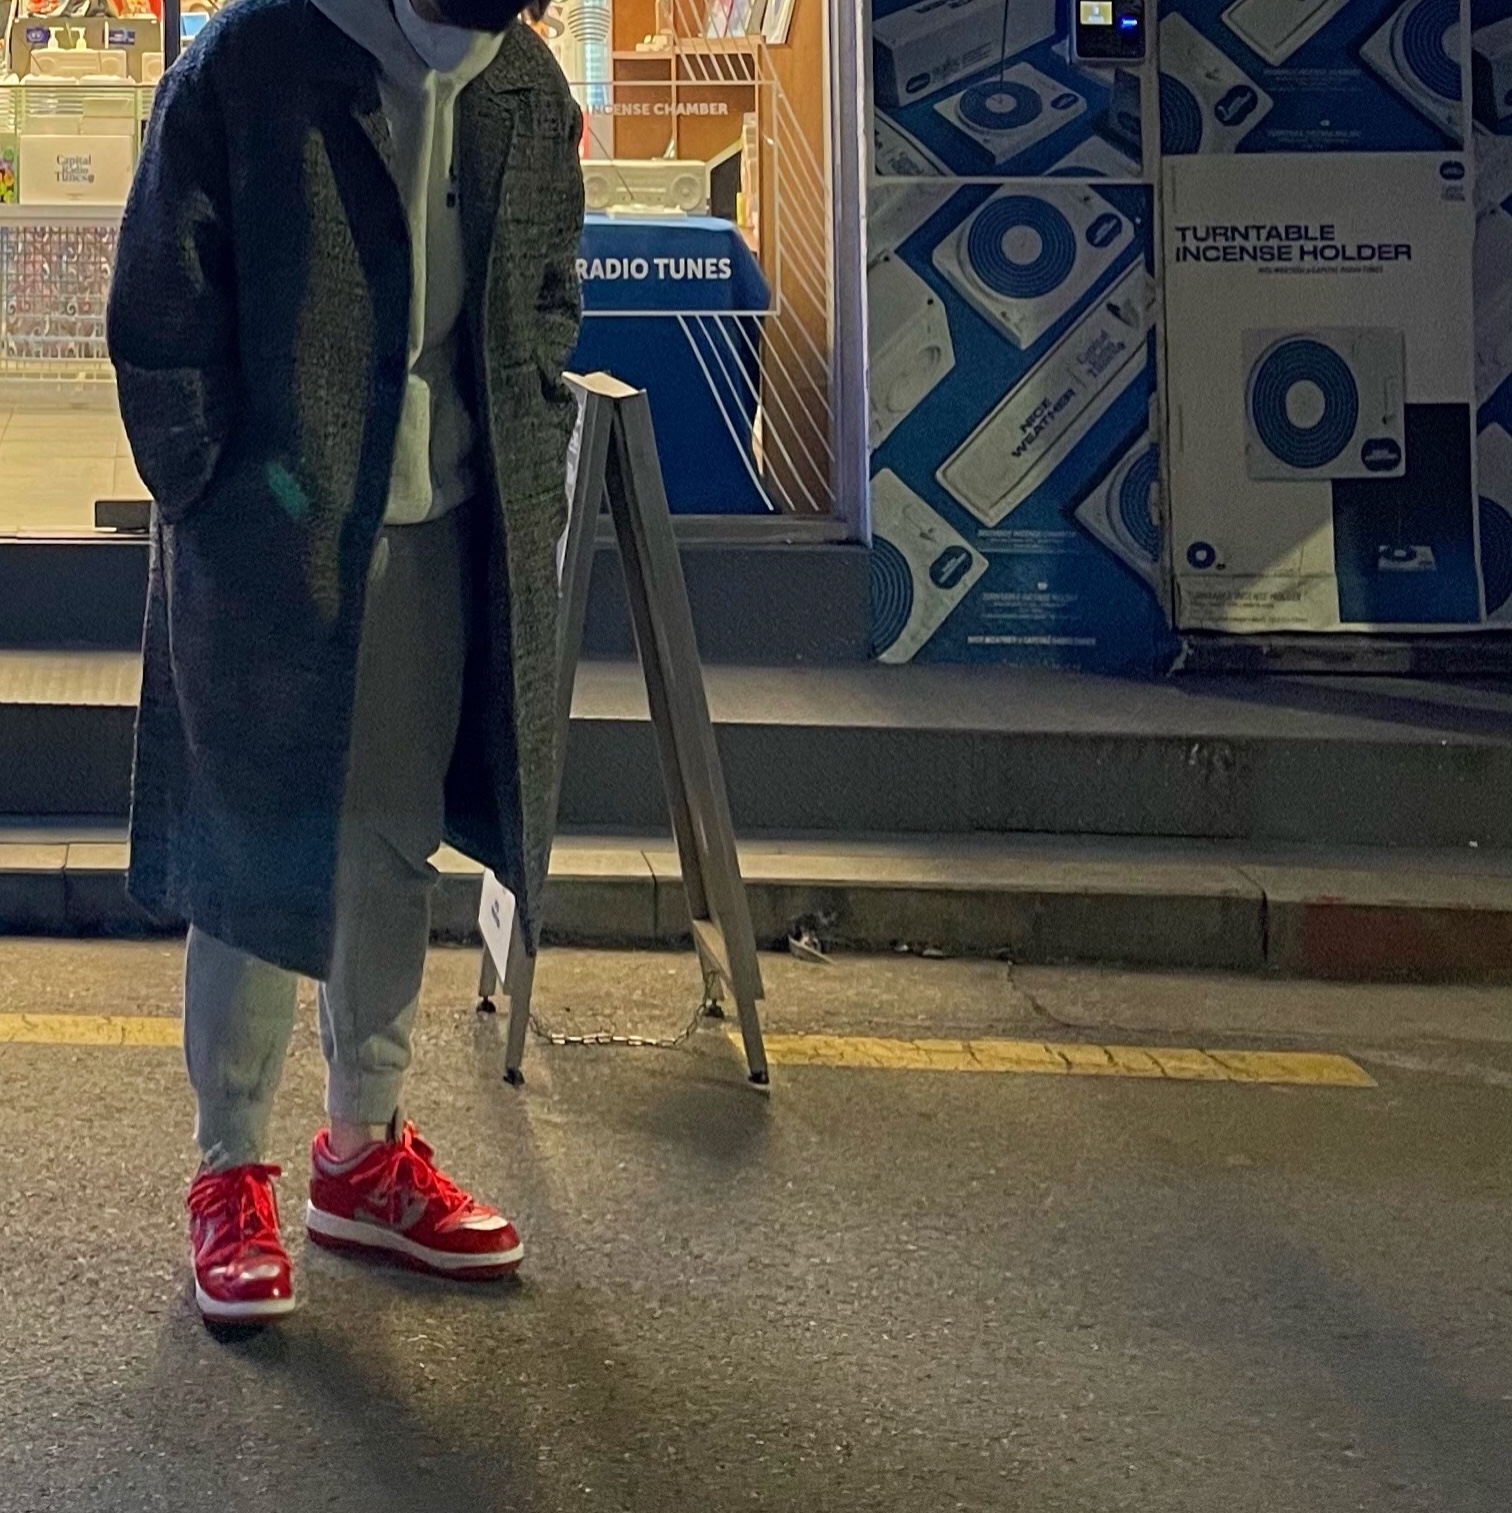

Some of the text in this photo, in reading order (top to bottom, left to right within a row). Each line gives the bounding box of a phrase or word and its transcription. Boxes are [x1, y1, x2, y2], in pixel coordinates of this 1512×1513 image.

[653, 102, 729, 116] CHAMBER
[56, 154, 92, 168] Capital
[1175, 224, 1335, 242] TURNTABLE
[1175, 244, 1412, 262] INCENSE HOLDER
[575, 257, 732, 280] RADIO TUNES
